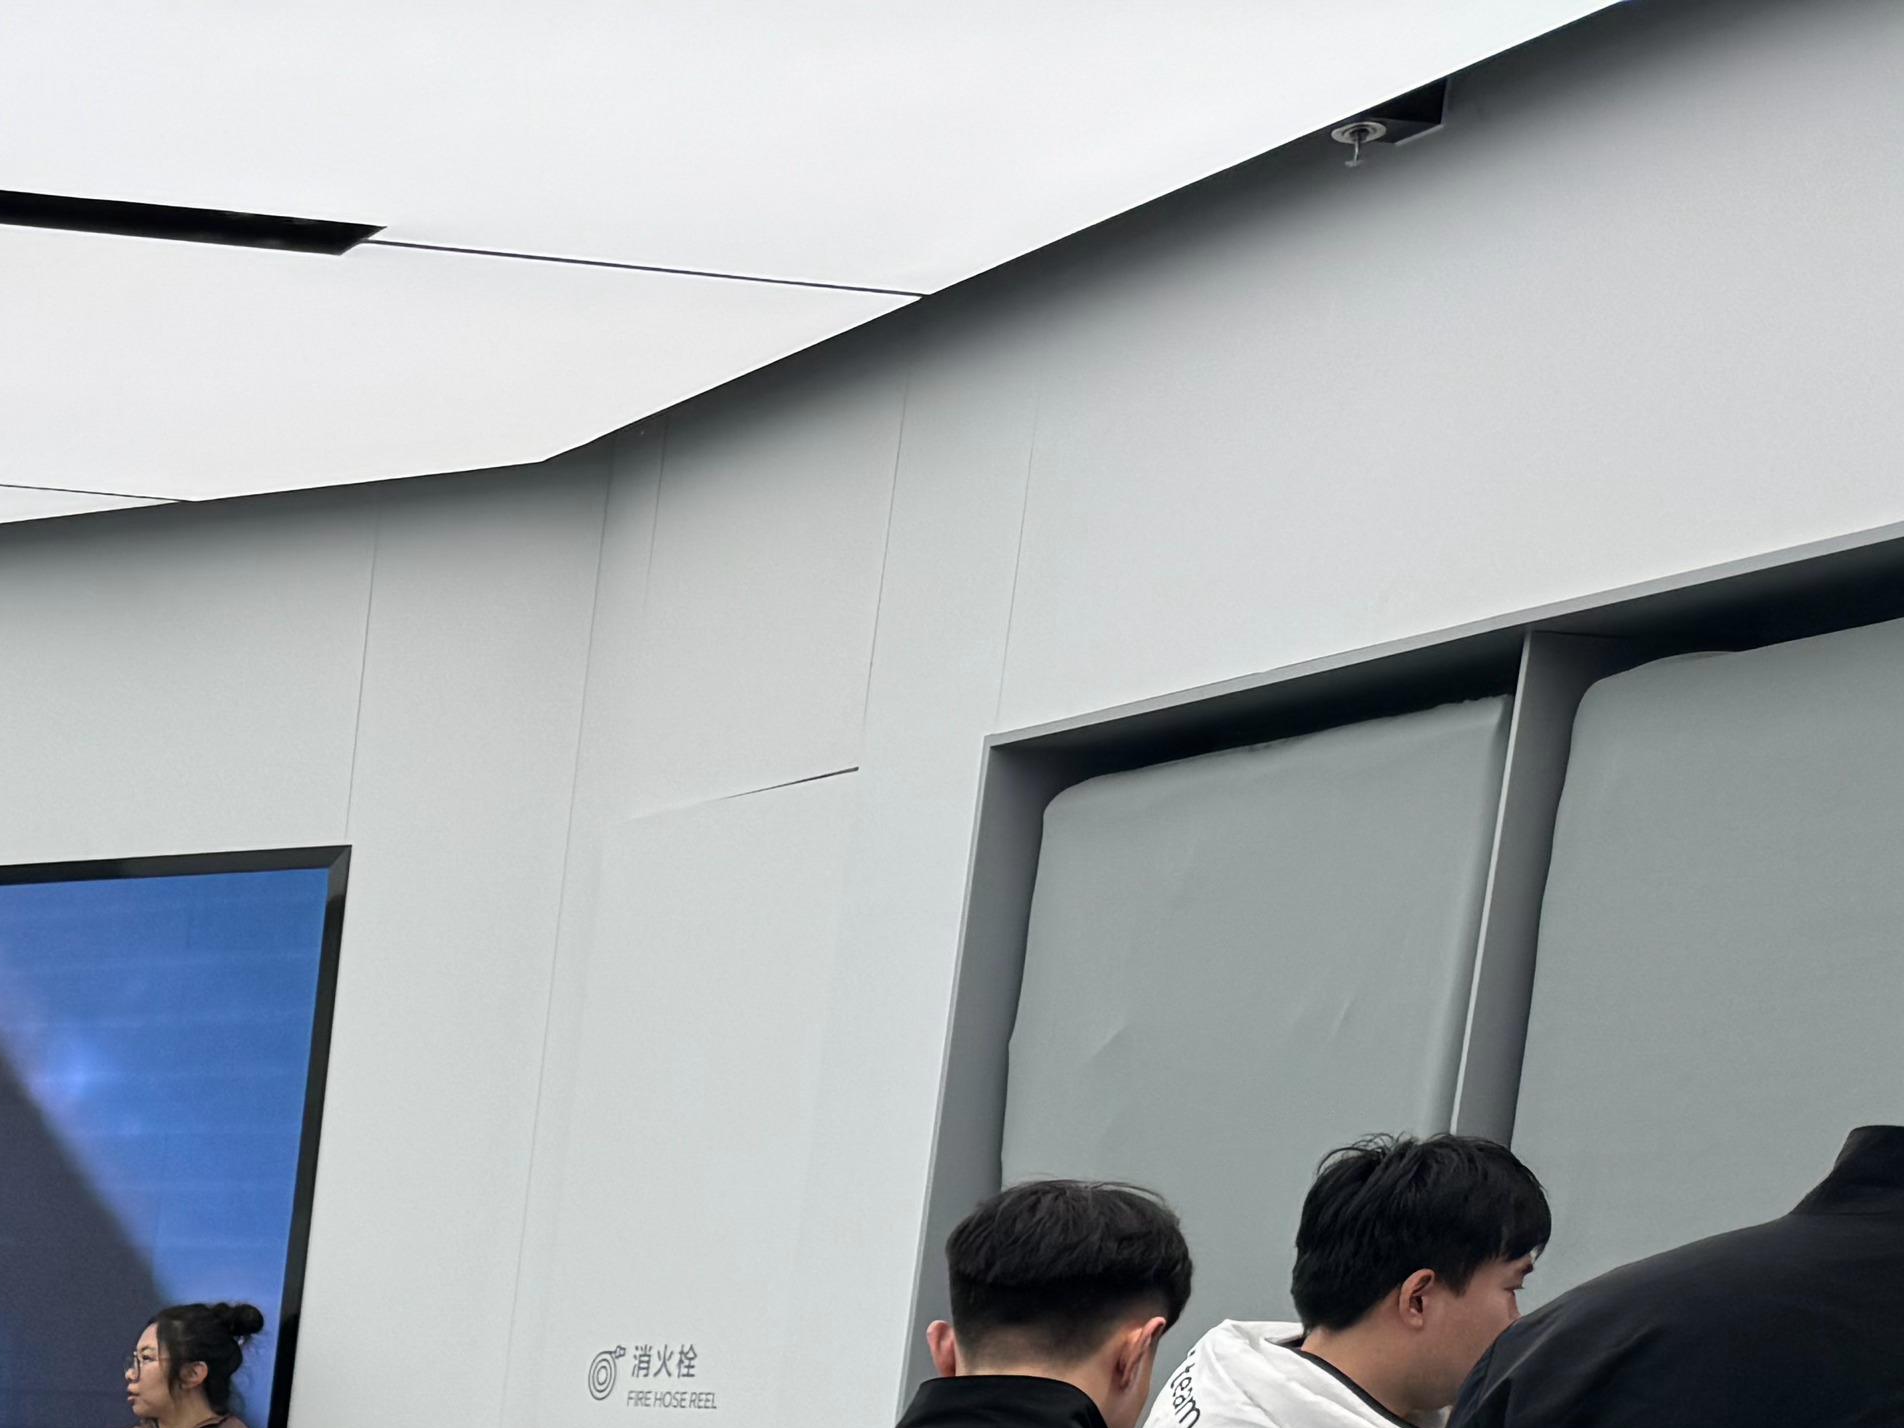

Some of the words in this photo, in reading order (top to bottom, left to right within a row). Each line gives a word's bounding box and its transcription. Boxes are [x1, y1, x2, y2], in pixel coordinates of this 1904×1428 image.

[631, 1344, 697, 1379] 消火栓
[627, 1390, 652, 1407] FIRE
[653, 1391, 687, 1408] HOSE
[688, 1392, 717, 1409] REEL
